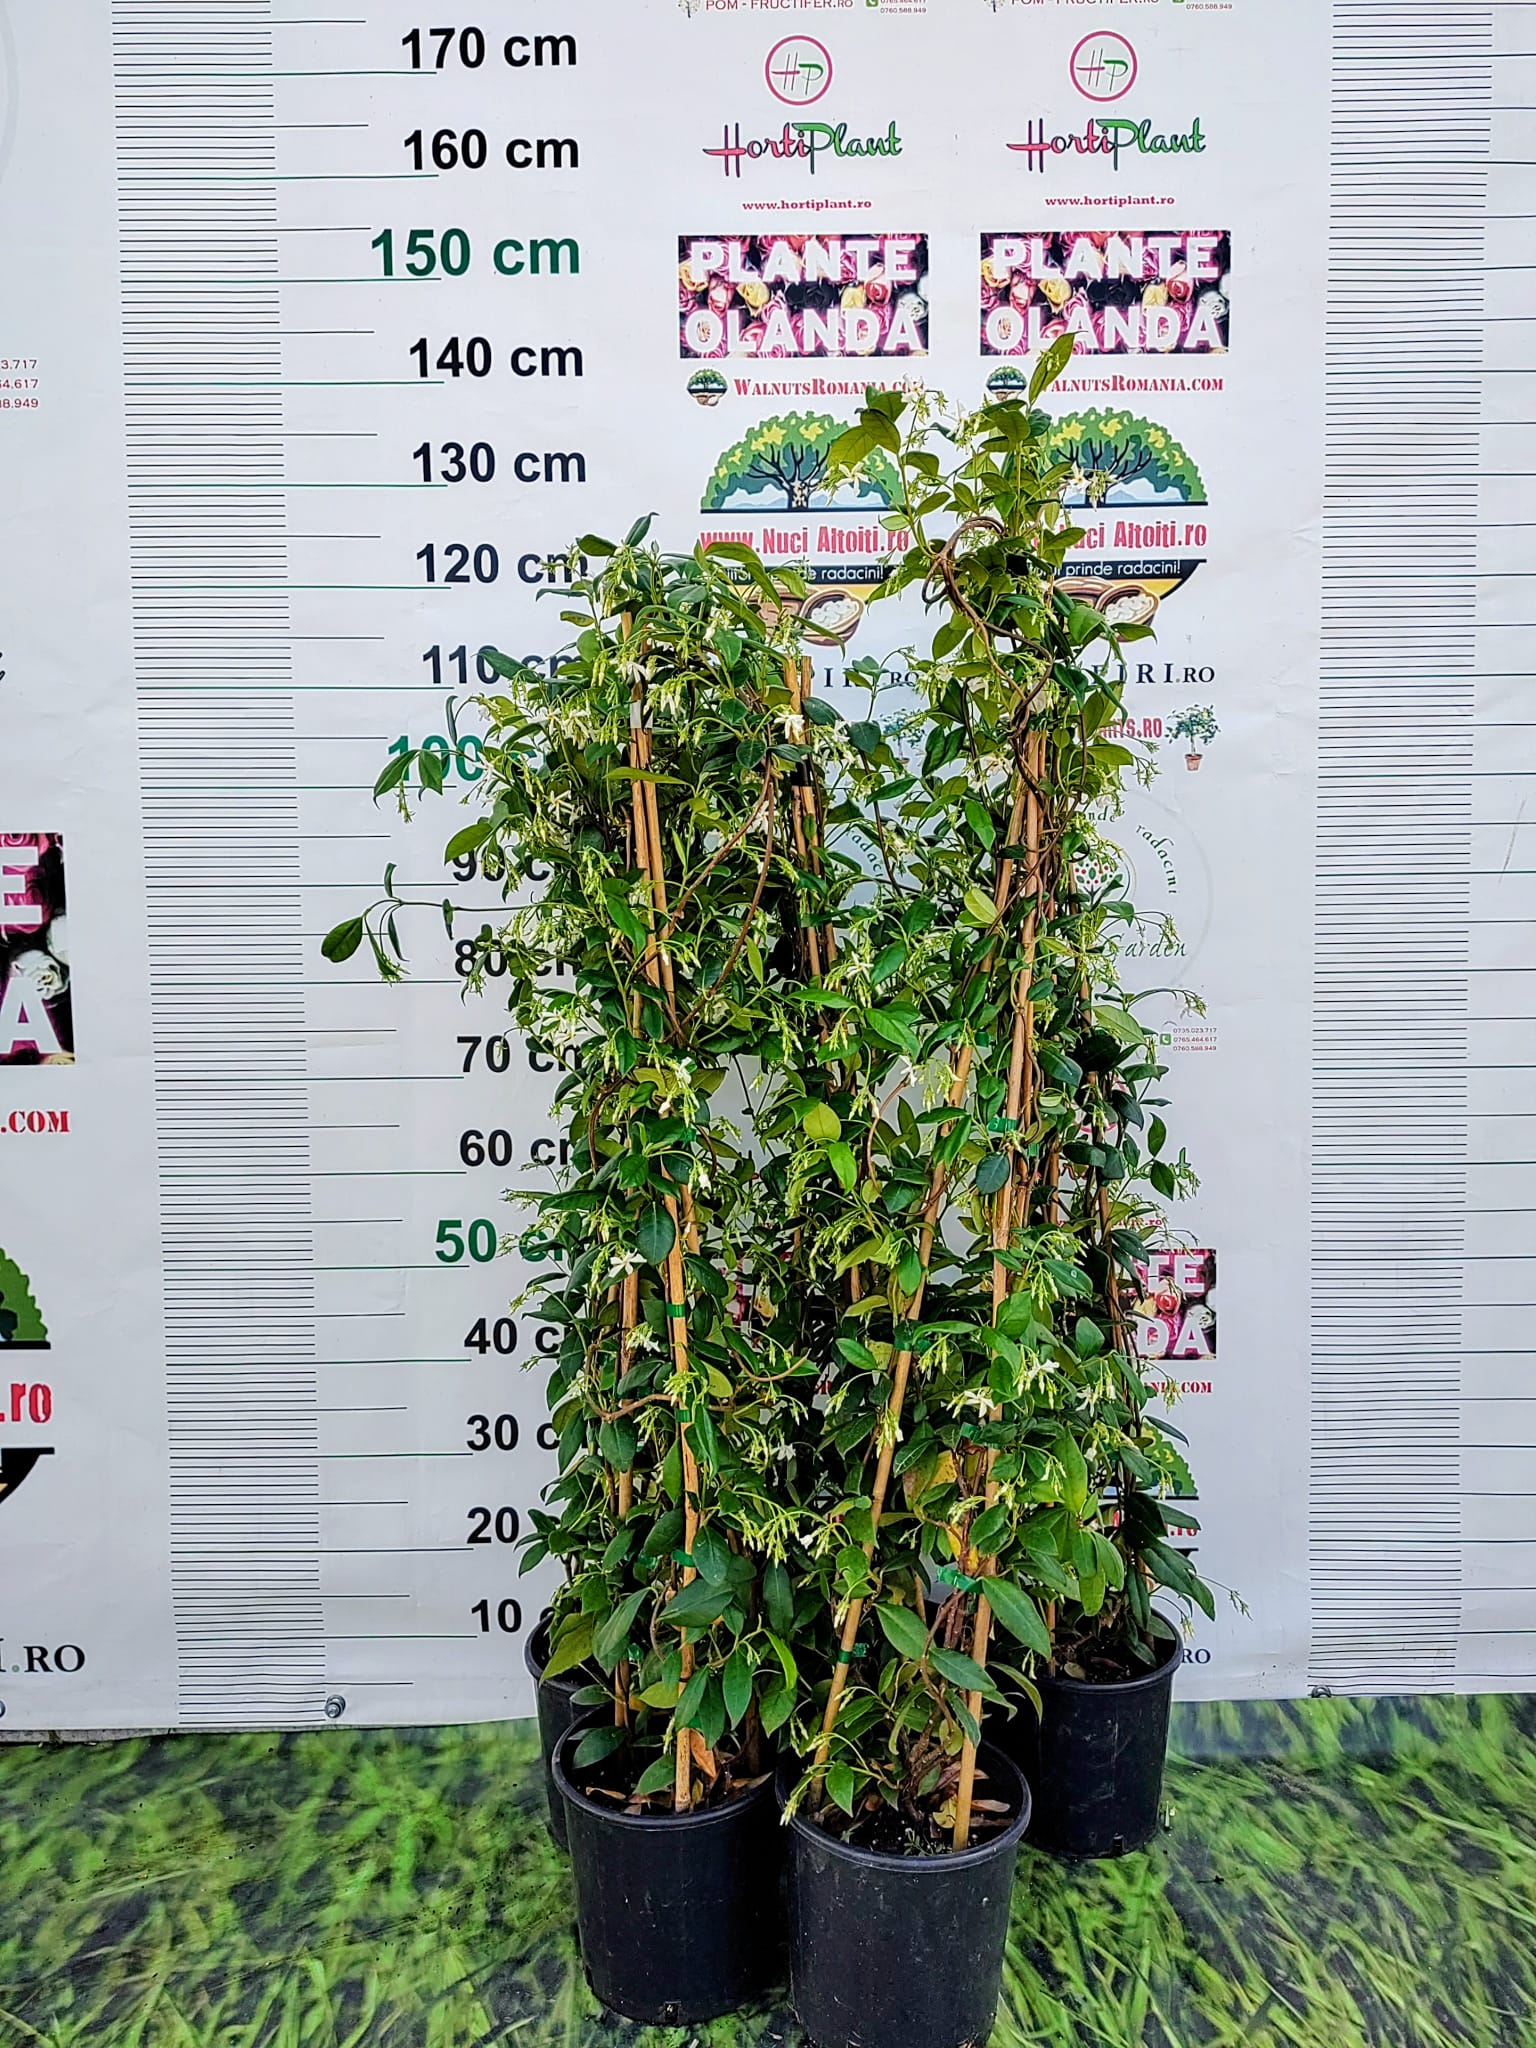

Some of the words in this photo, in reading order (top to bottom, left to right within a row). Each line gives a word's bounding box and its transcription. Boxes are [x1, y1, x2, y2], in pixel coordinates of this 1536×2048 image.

[402, 27, 485, 69] 170
[503, 35, 577, 67] cm
[404, 129, 487, 170] 160
[505, 138, 579, 169] cm
[702, 120, 903, 178] HortiPlant
[1006, 117, 1206, 173] HortiPlant
[742, 199, 873, 212] www.hortiplant.ro
[1045, 196, 1175, 208] www.hortiplant.ro
[371, 228, 471, 277] 150
[493, 238, 580, 276] cm
[690, 240, 917, 283] PLANTE
[993, 237, 1220, 280] PLANTE
[685, 308, 924, 352] OLANDA
[986, 306, 1223, 350] OLANDA
[409, 337, 493, 378] 140
[510, 347, 584, 377] cm
[1043, 375, 1224, 392] ALNUTSROMANIA.COM
[412, 442, 496, 483] 130
[514, 452, 587, 483] cm
[817, 526, 910, 554] Altoiti.ro
[1114, 520, 1208, 549] Altoiti.ro
[416, 543, 500, 583] 120
[821, 568, 884, 581] radacini!
[1065, 562, 1113, 577] prinde
[1117, 562, 1181, 576] radacini!
[422, 645, 501, 684] 110
[387, 735, 484, 782] 100
[454, 939, 508, 977] 80
[457, 1035, 511, 1073] 70
[459, 1129, 513, 1167] 60
[435, 1218, 497, 1263] 50
[464, 1317, 518, 1355] 40
[466, 1414, 519, 1451] 30
[467, 1506, 520, 1544] 20
[471, 1598, 522, 1633] 10
